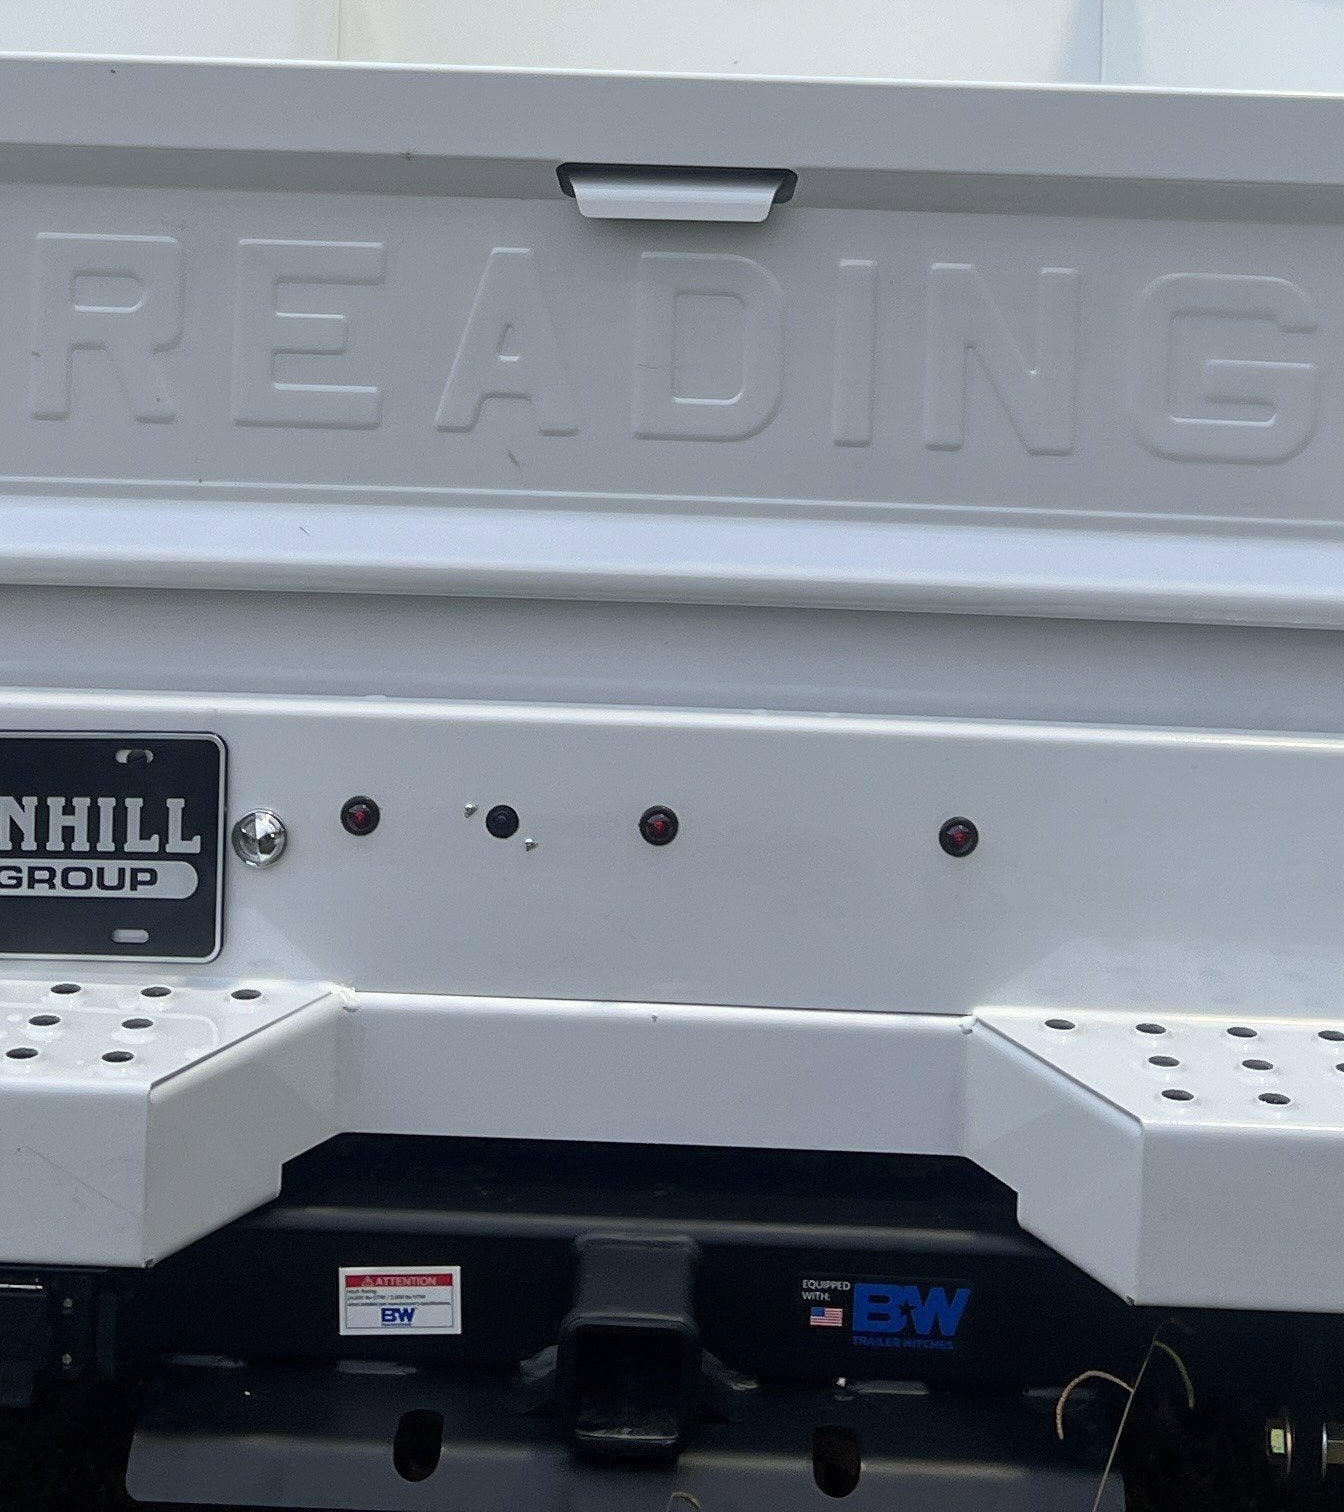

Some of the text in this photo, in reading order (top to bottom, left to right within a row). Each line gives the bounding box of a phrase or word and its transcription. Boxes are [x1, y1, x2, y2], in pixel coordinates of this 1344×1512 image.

[29, 231, 1319, 465] READING
[375, 1276, 437, 1286] ATTENTION
[801, 1279, 851, 1291] EQUIPPED
[801, 1291, 831, 1301] WITH:
[852, 1335, 901, 1348] TRAILER
